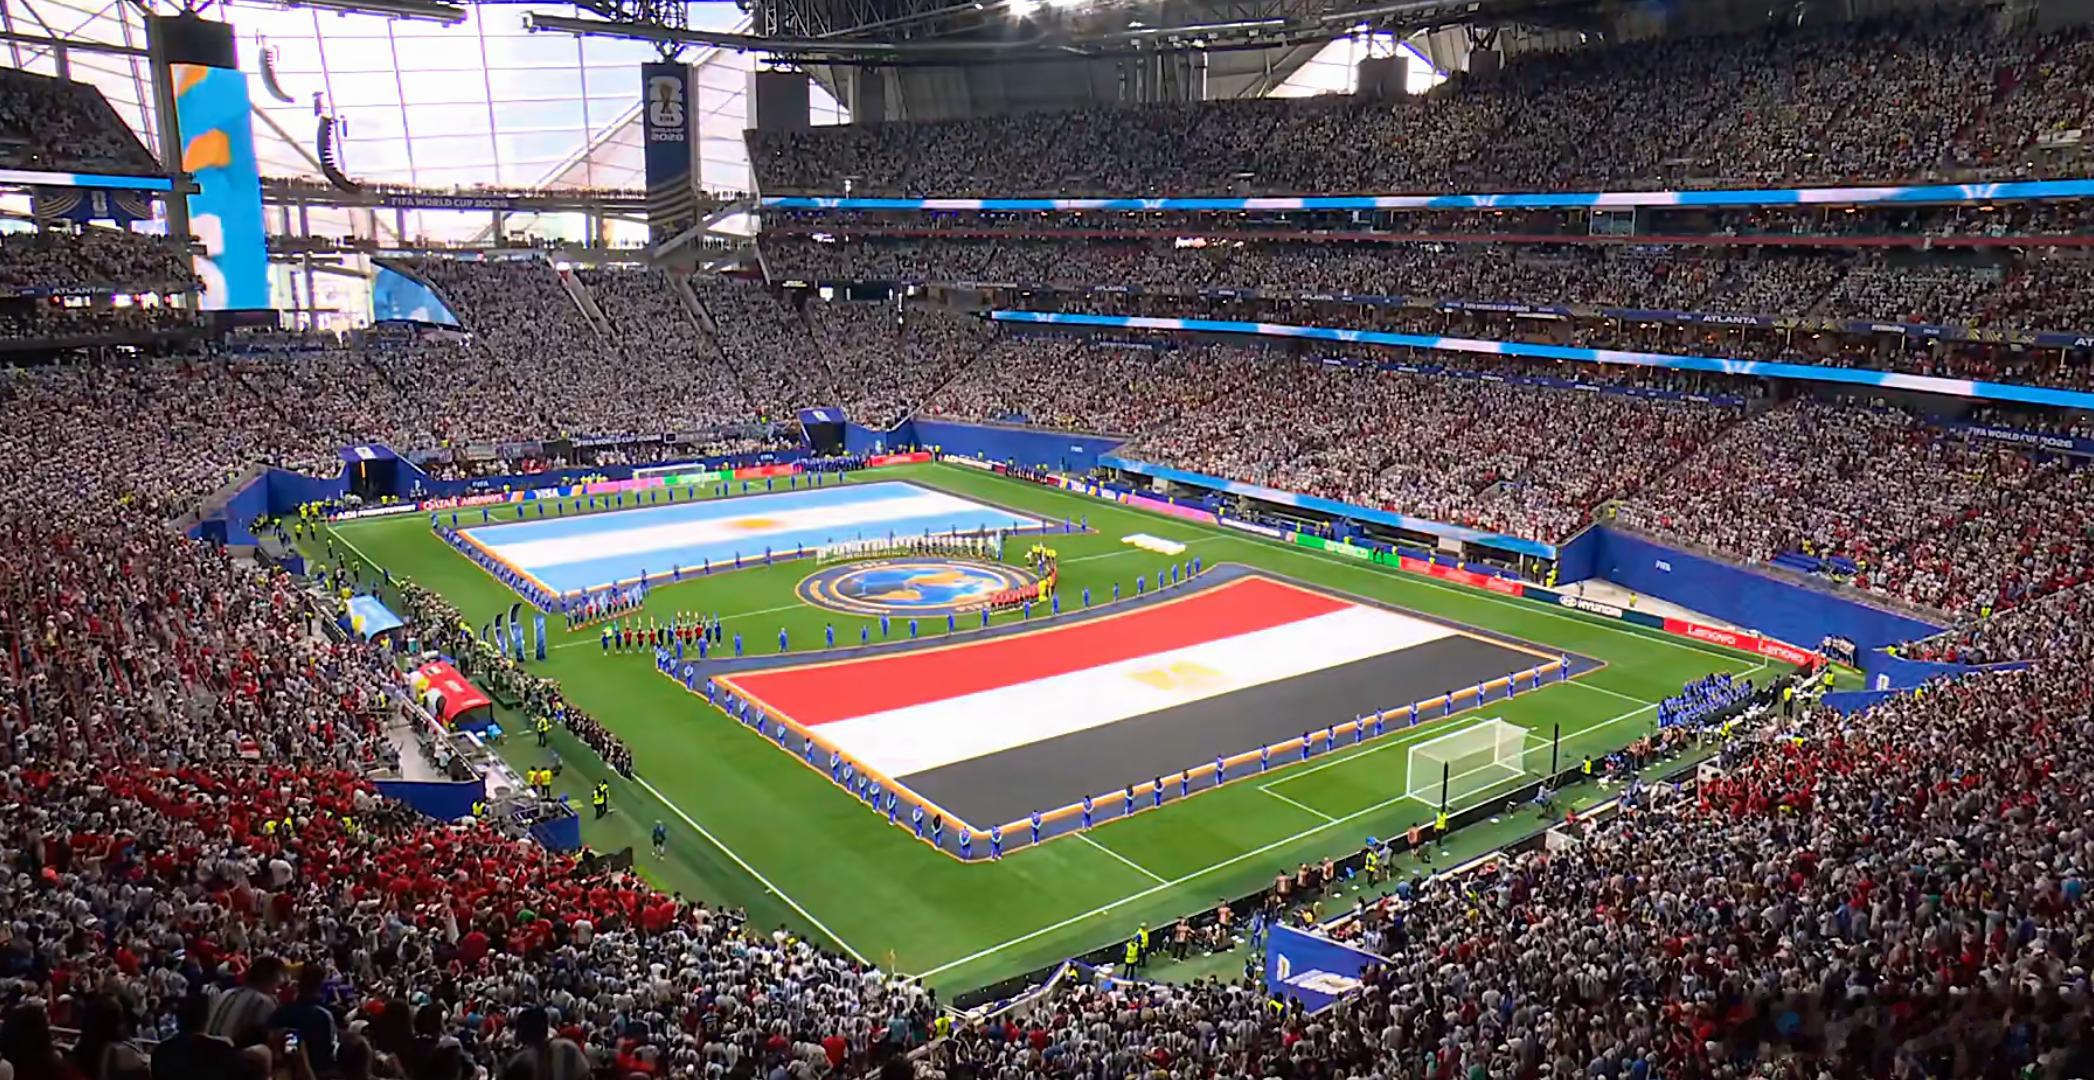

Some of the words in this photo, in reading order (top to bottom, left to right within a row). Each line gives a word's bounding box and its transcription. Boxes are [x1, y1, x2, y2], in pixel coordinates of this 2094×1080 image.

[416, 198, 452, 207] WORLD
[1702, 313, 1758, 325] ATLANTA
[1968, 426, 1987, 437] FIFA
[1988, 428, 2019, 442] WORLD
[423, 498, 457, 511] QATAR
[1578, 599, 1622, 618] HYUNDAI
[1688, 623, 1736, 645] Lenovo
[1758, 638, 1805, 662] Lenovo
